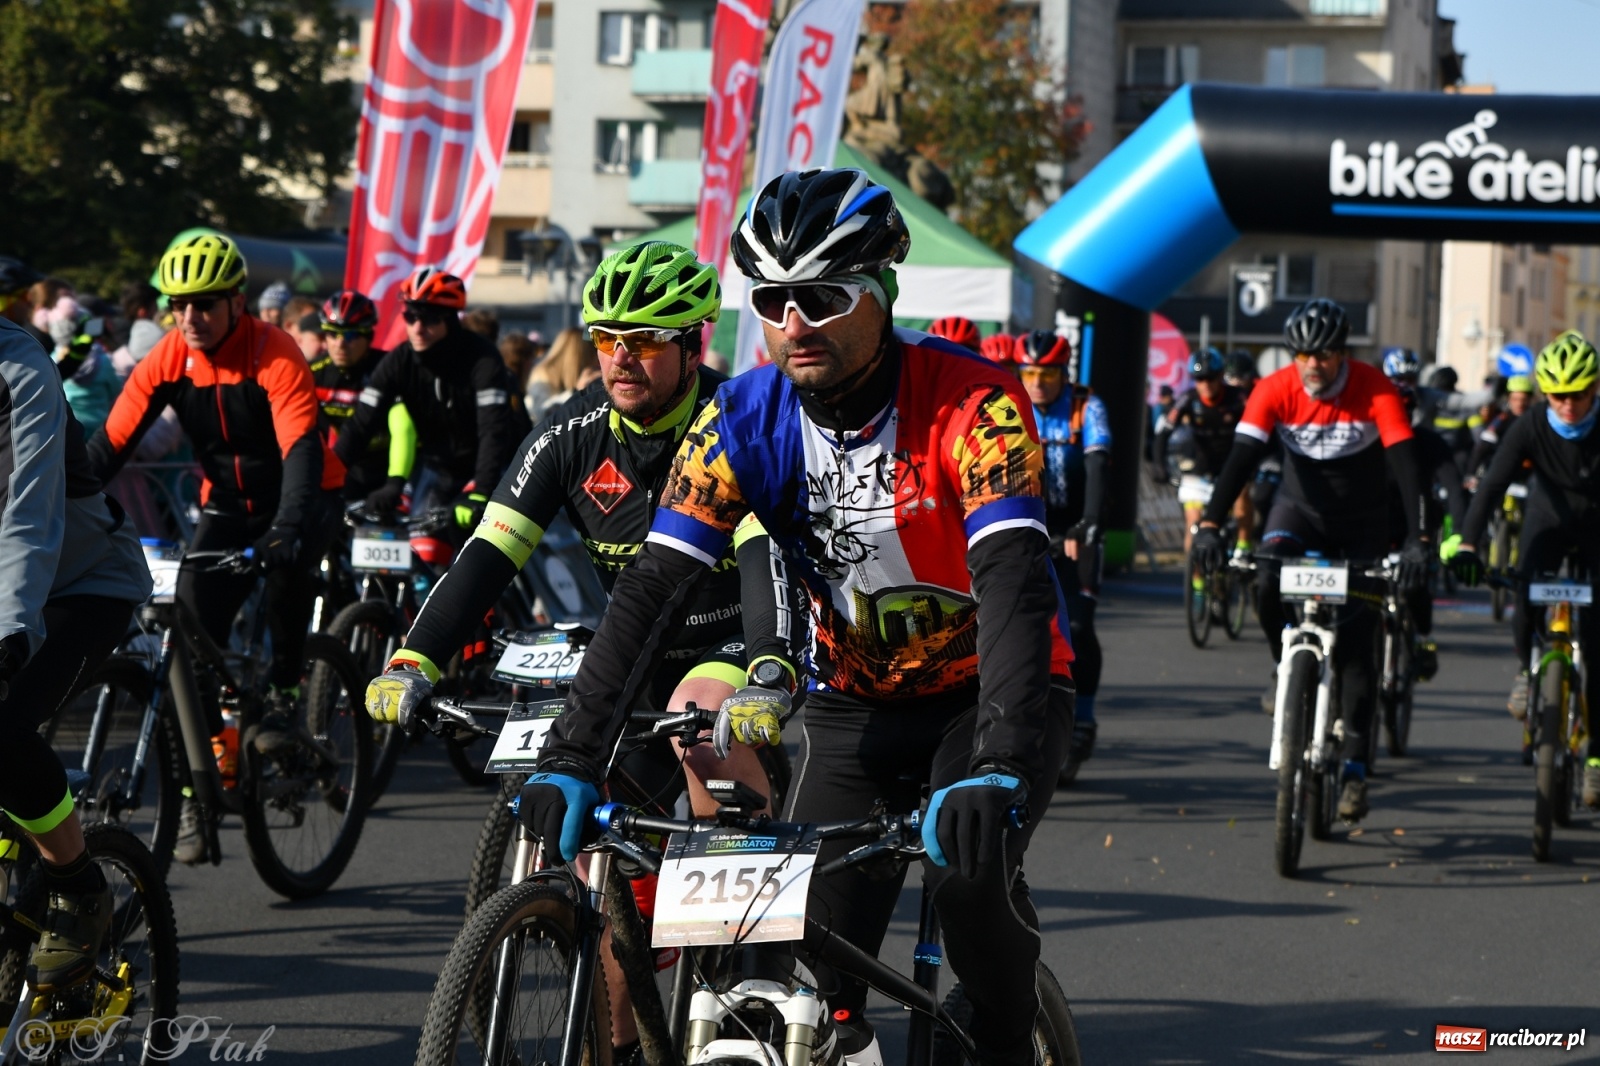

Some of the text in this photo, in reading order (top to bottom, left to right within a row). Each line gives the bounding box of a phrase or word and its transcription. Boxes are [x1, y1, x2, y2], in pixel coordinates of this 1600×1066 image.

[787, 24, 836, 172] RAC
[1328, 138, 1600, 203] bike ateli
[510, 401, 610, 499] LEADER FOX
[363, 547, 401, 562] 3031
[579, 533, 645, 557] EAD
[1294, 572, 1337, 588] 1756
[1542, 588, 1582, 598] 3017
[686, 603, 743, 626] ountain
[706, 840, 777, 850] MTBMARATON
[680, 866, 784, 906] 2155
